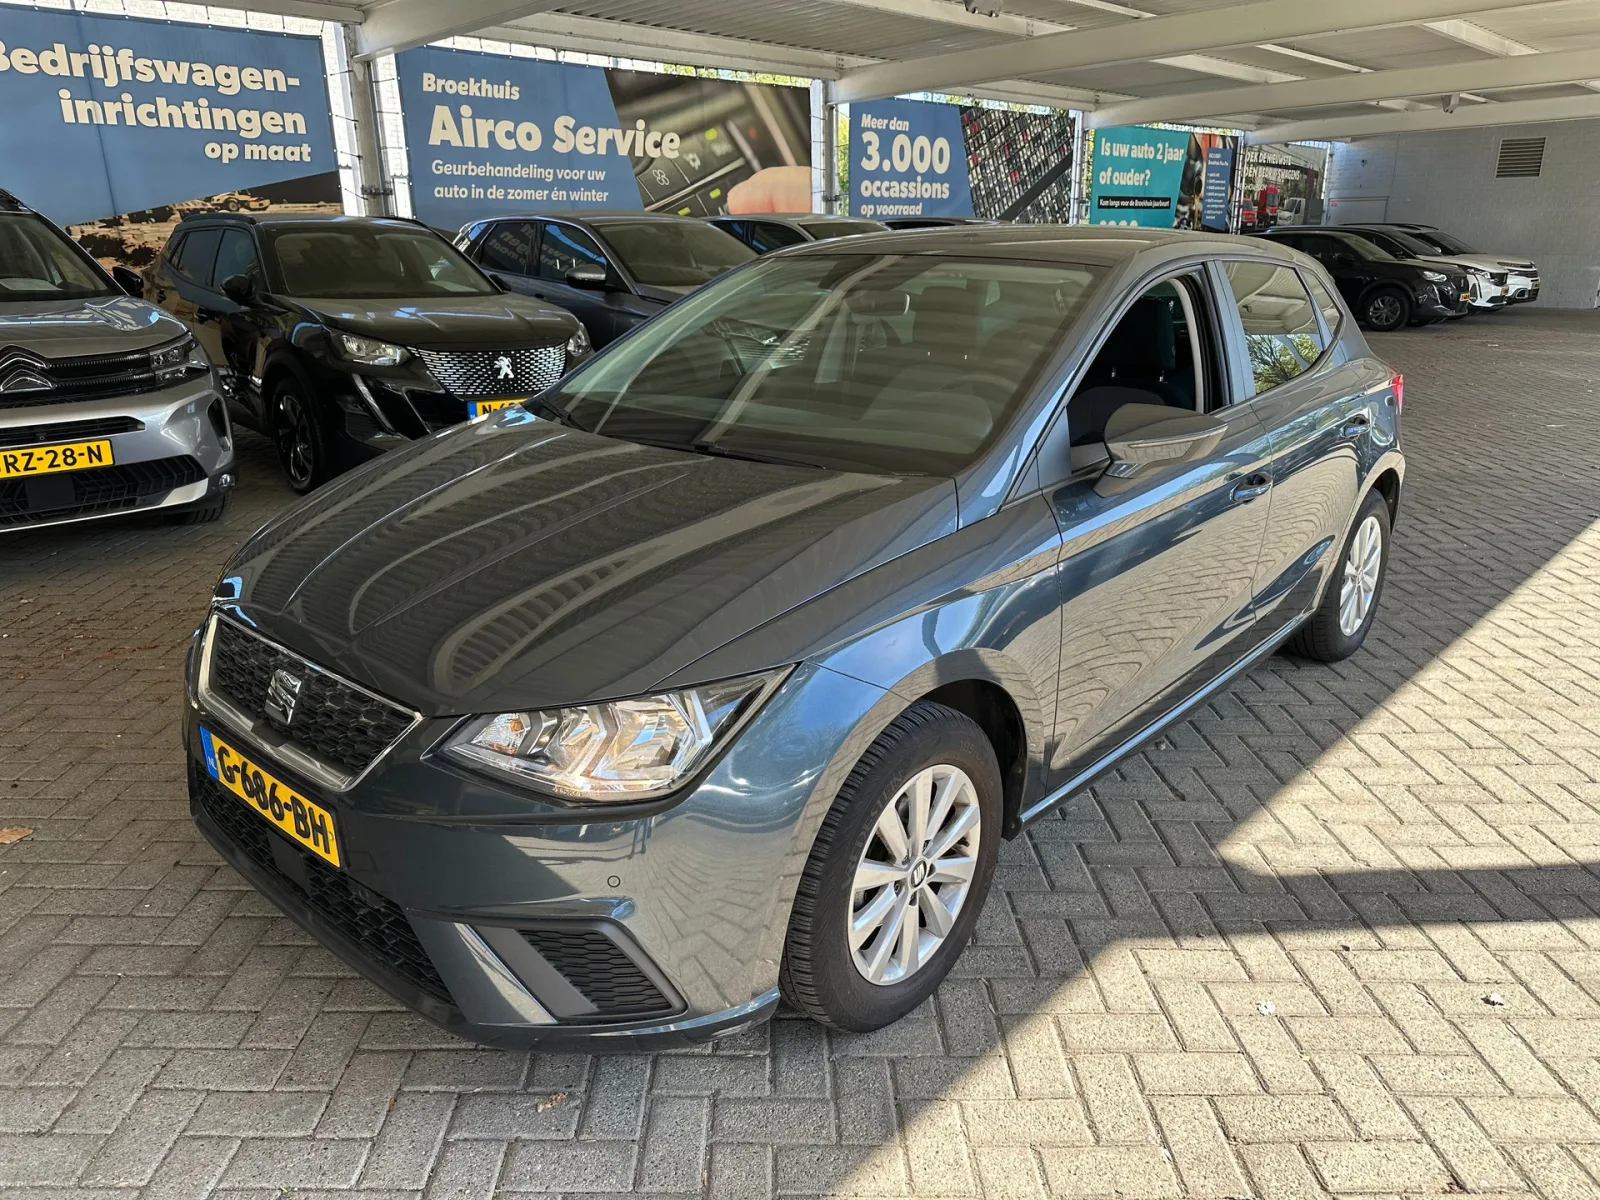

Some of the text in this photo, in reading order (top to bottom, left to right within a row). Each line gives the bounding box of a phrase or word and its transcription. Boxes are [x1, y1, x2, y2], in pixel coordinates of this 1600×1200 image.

[422, 72, 520, 100] Broekhuis
[58, 88, 307, 139] inrichtingen
[861, 113, 909, 131] Meer dan
[428, 104, 681, 159] Airco Service
[204, 143, 311, 164] op maat
[860, 131, 950, 174] 3.000
[1101, 137, 1184, 164] Is uw auto 2 jaar
[431, 159, 606, 182] Geurbehandeling voor uw
[1099, 166, 1151, 187] of ouder?
[434, 184, 609, 202] auto in de zomer én winter
[860, 175, 950, 199] occassions
[861, 202, 923, 218] op voorraad
[0, 444, 103, 474] RZ-28-N
[217, 746, 331, 854] G-686-BH
